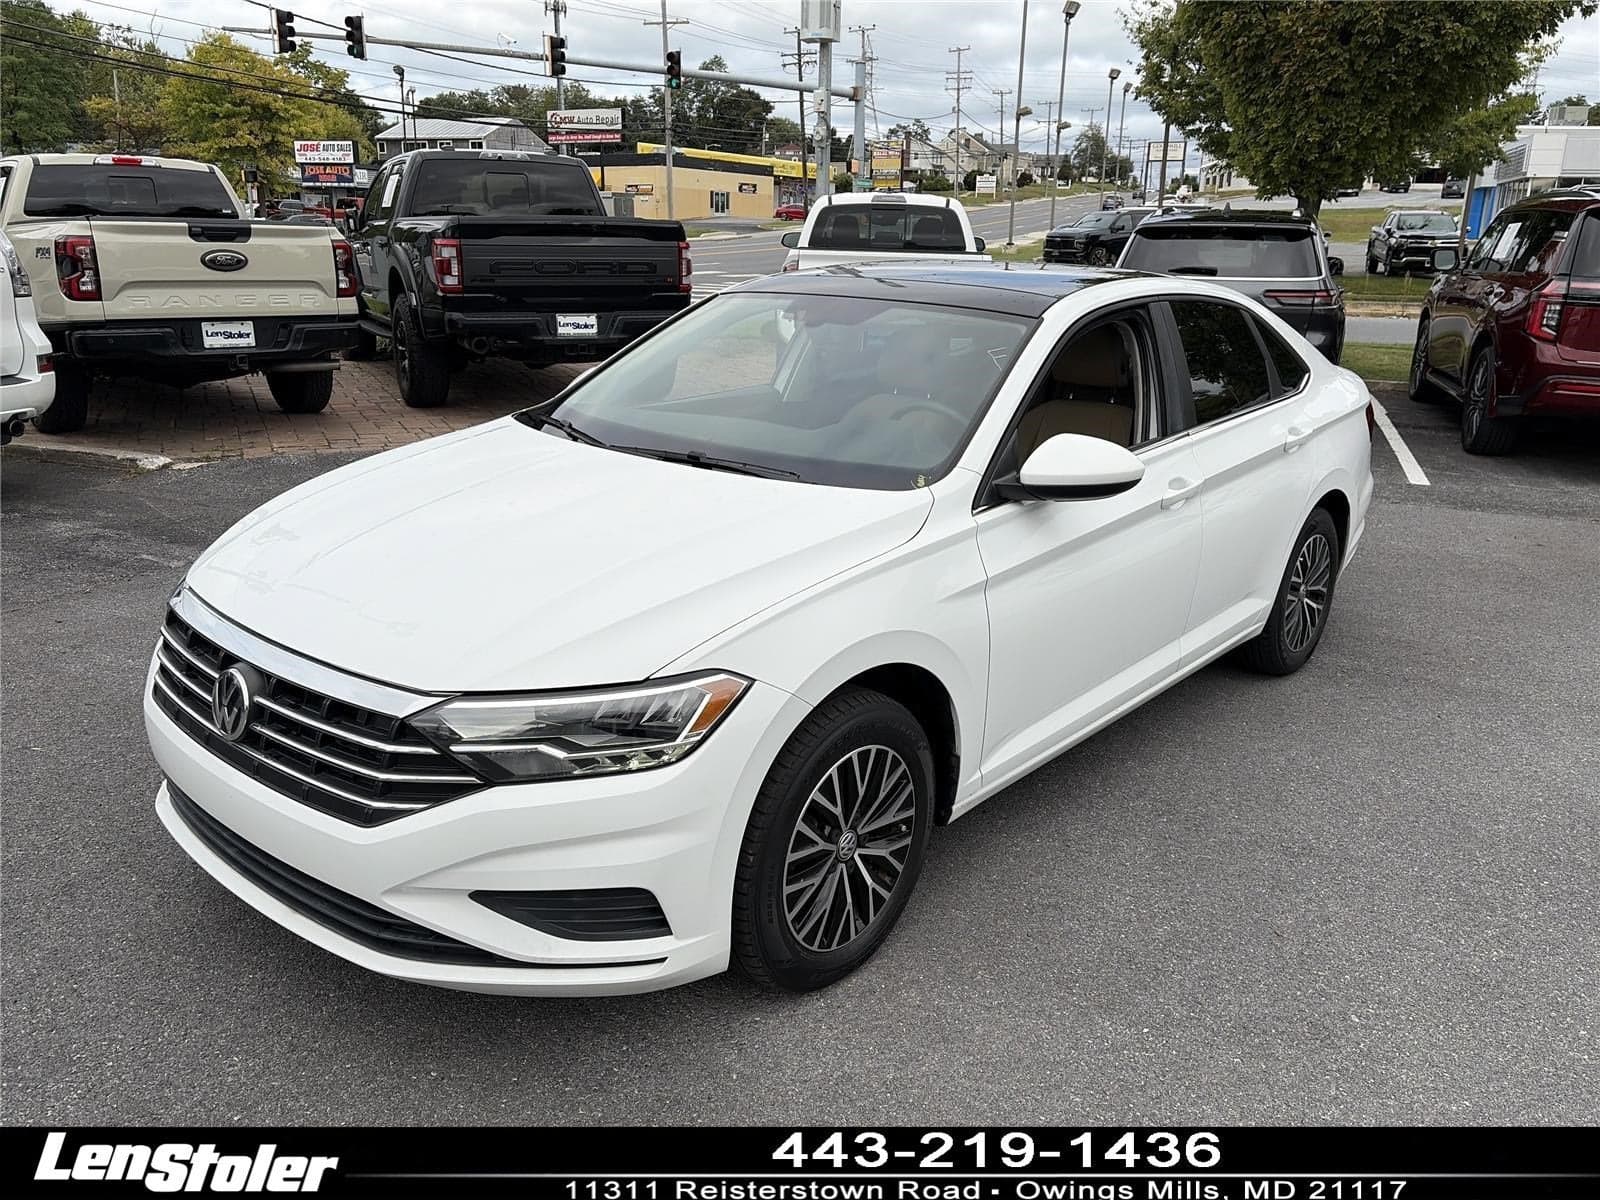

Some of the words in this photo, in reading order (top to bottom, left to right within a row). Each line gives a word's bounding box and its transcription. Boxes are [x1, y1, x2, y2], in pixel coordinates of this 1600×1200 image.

[577, 115, 593, 124] Auto
[595, 114, 619, 127] Repair
[296, 141, 321, 152] JOSÉ
[322, 143, 336, 152] AUTO
[336, 143, 352, 152] SALES
[325, 165, 350, 175] AUTO
[489, 257, 658, 274] FORD
[126, 294, 321, 308] RANGER
